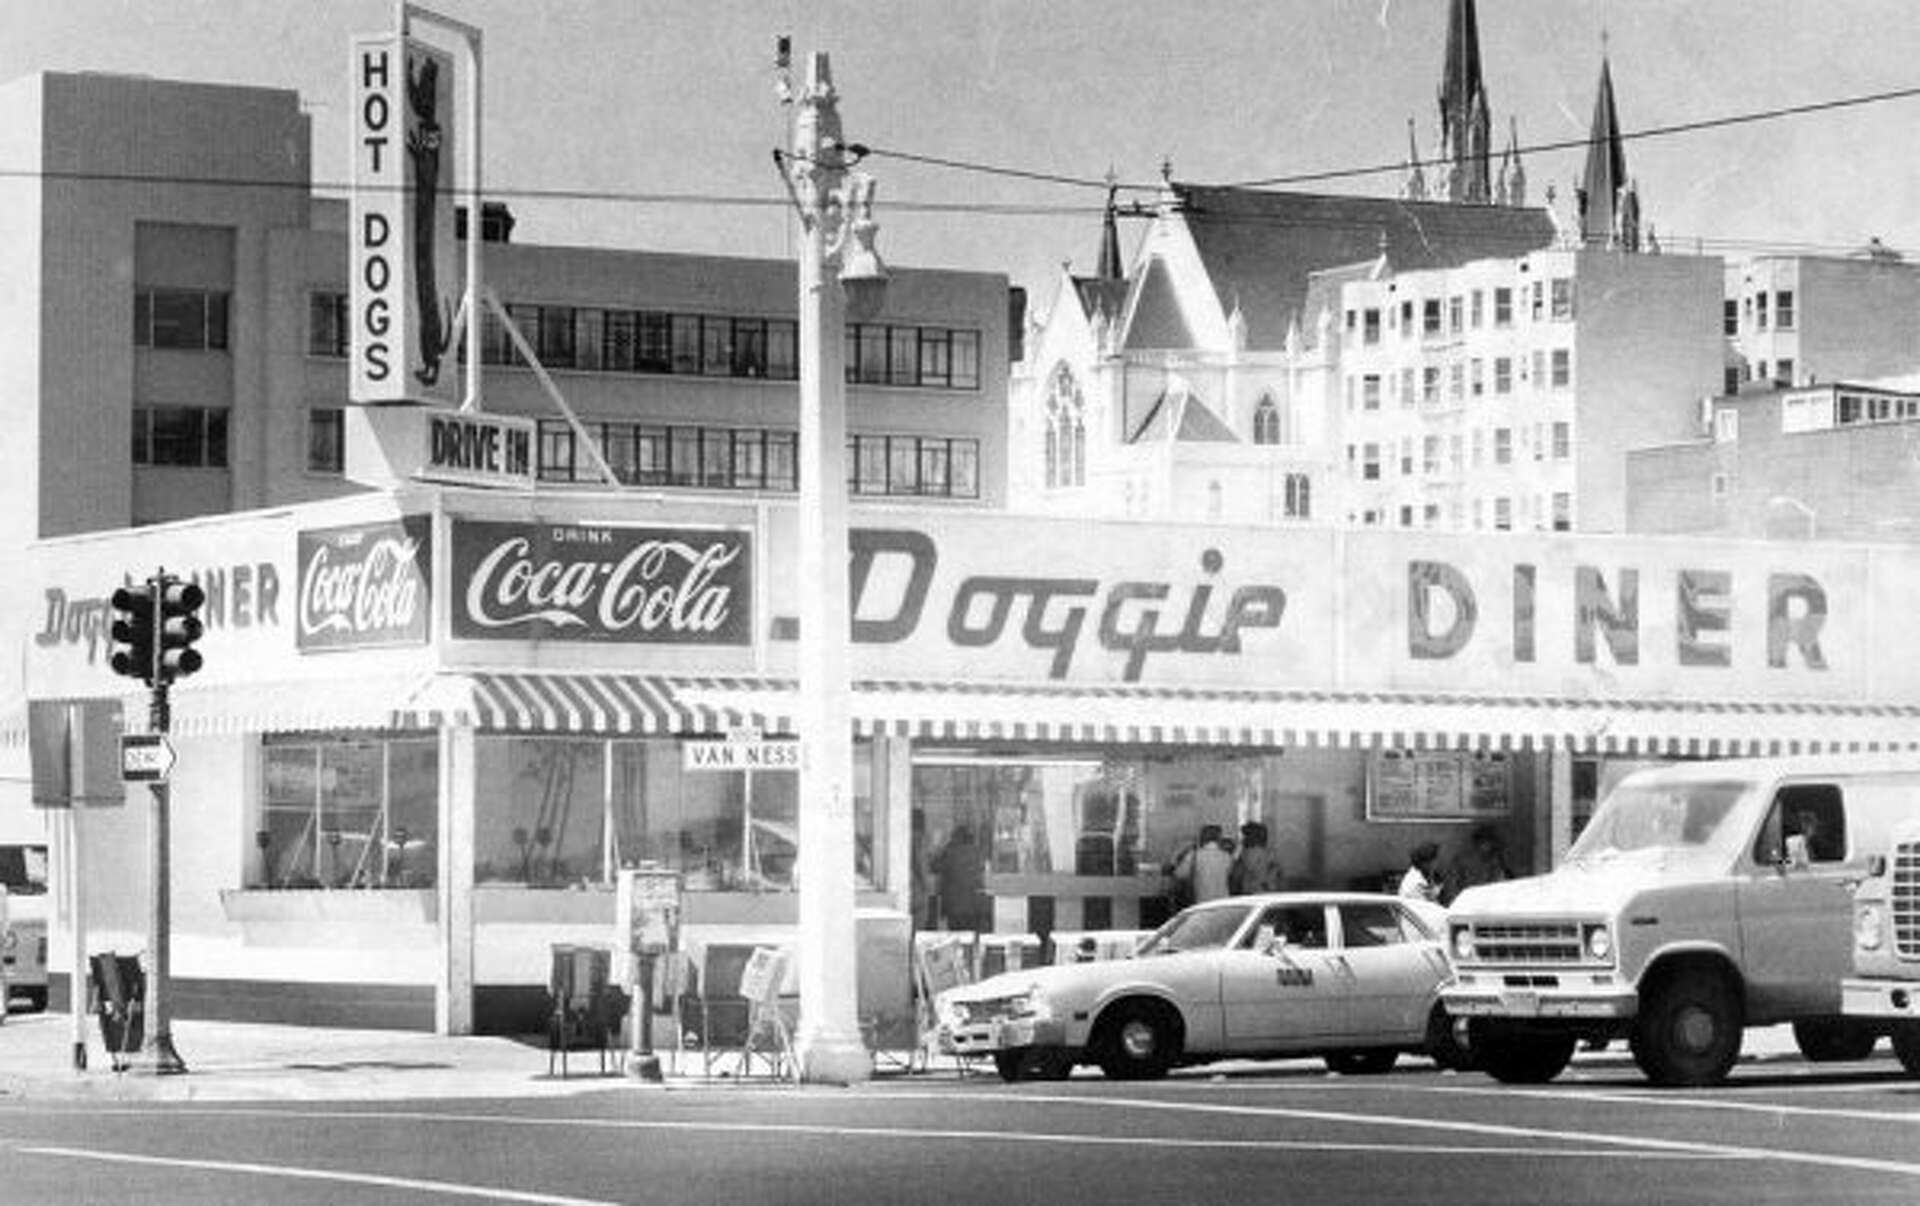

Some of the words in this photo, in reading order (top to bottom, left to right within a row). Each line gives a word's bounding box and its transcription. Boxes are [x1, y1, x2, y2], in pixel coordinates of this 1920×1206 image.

[363, 51, 389, 173] HOT
[363, 213, 391, 381] DOGS
[431, 418, 499, 471] DRIVE
[505, 427, 529, 476] IN
[551, 527, 613, 543] DRINK
[191, 562, 280, 629] NER
[466, 535, 740, 631] Coca-Cola
[1407, 560, 1830, 670] DINER
[692, 746, 733, 765] VAN
[746, 745, 798, 765] NESS
